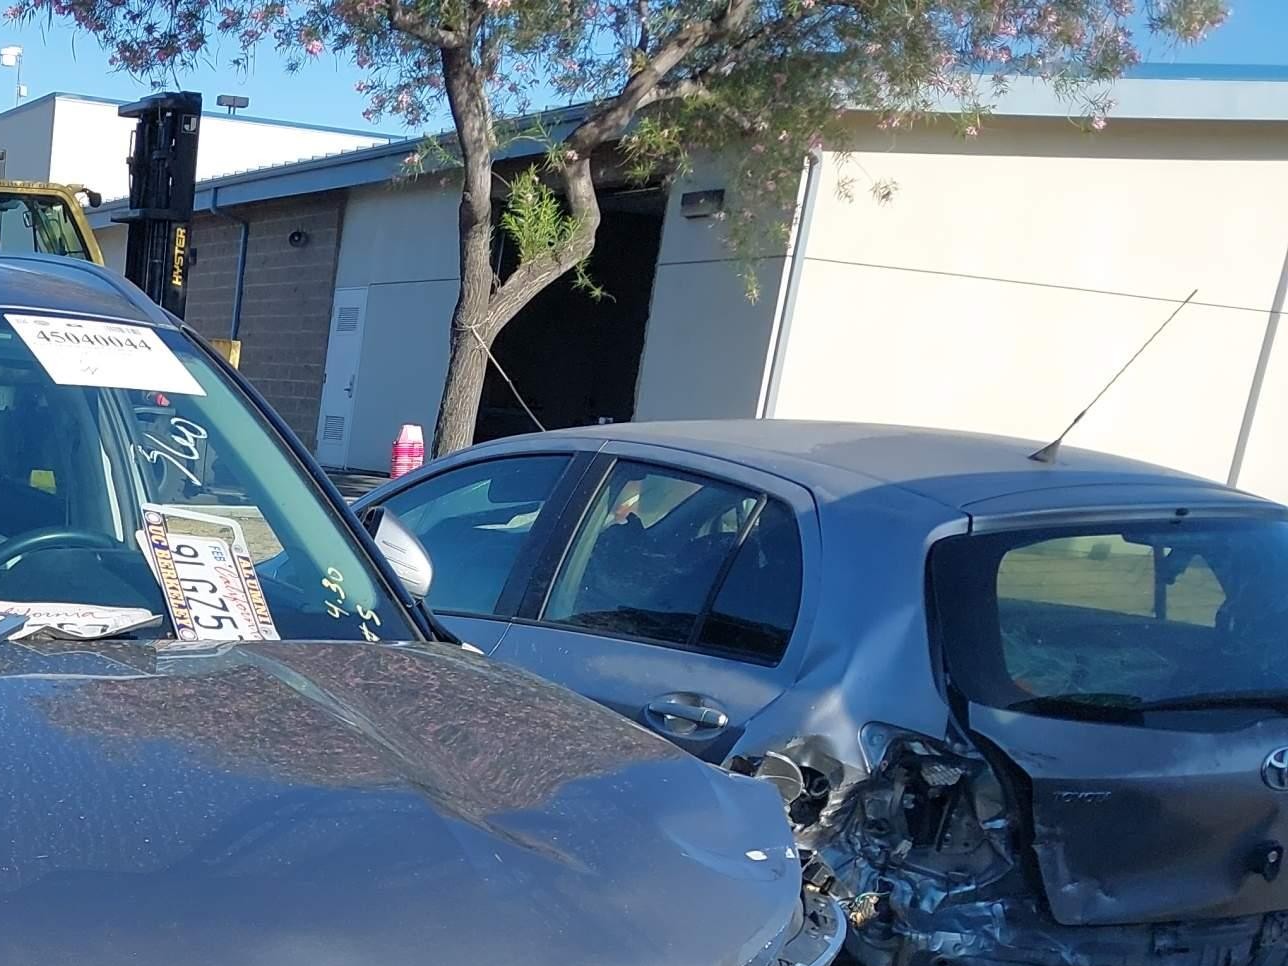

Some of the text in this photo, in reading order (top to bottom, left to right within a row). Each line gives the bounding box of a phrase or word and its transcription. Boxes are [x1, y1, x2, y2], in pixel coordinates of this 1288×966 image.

[172, 227, 186, 286] HYSTER
[36, 329, 153, 352] 45040044
[149, 524, 193, 628] UC BERKELEY
[239, 556, 272, 625] ALUMNI
